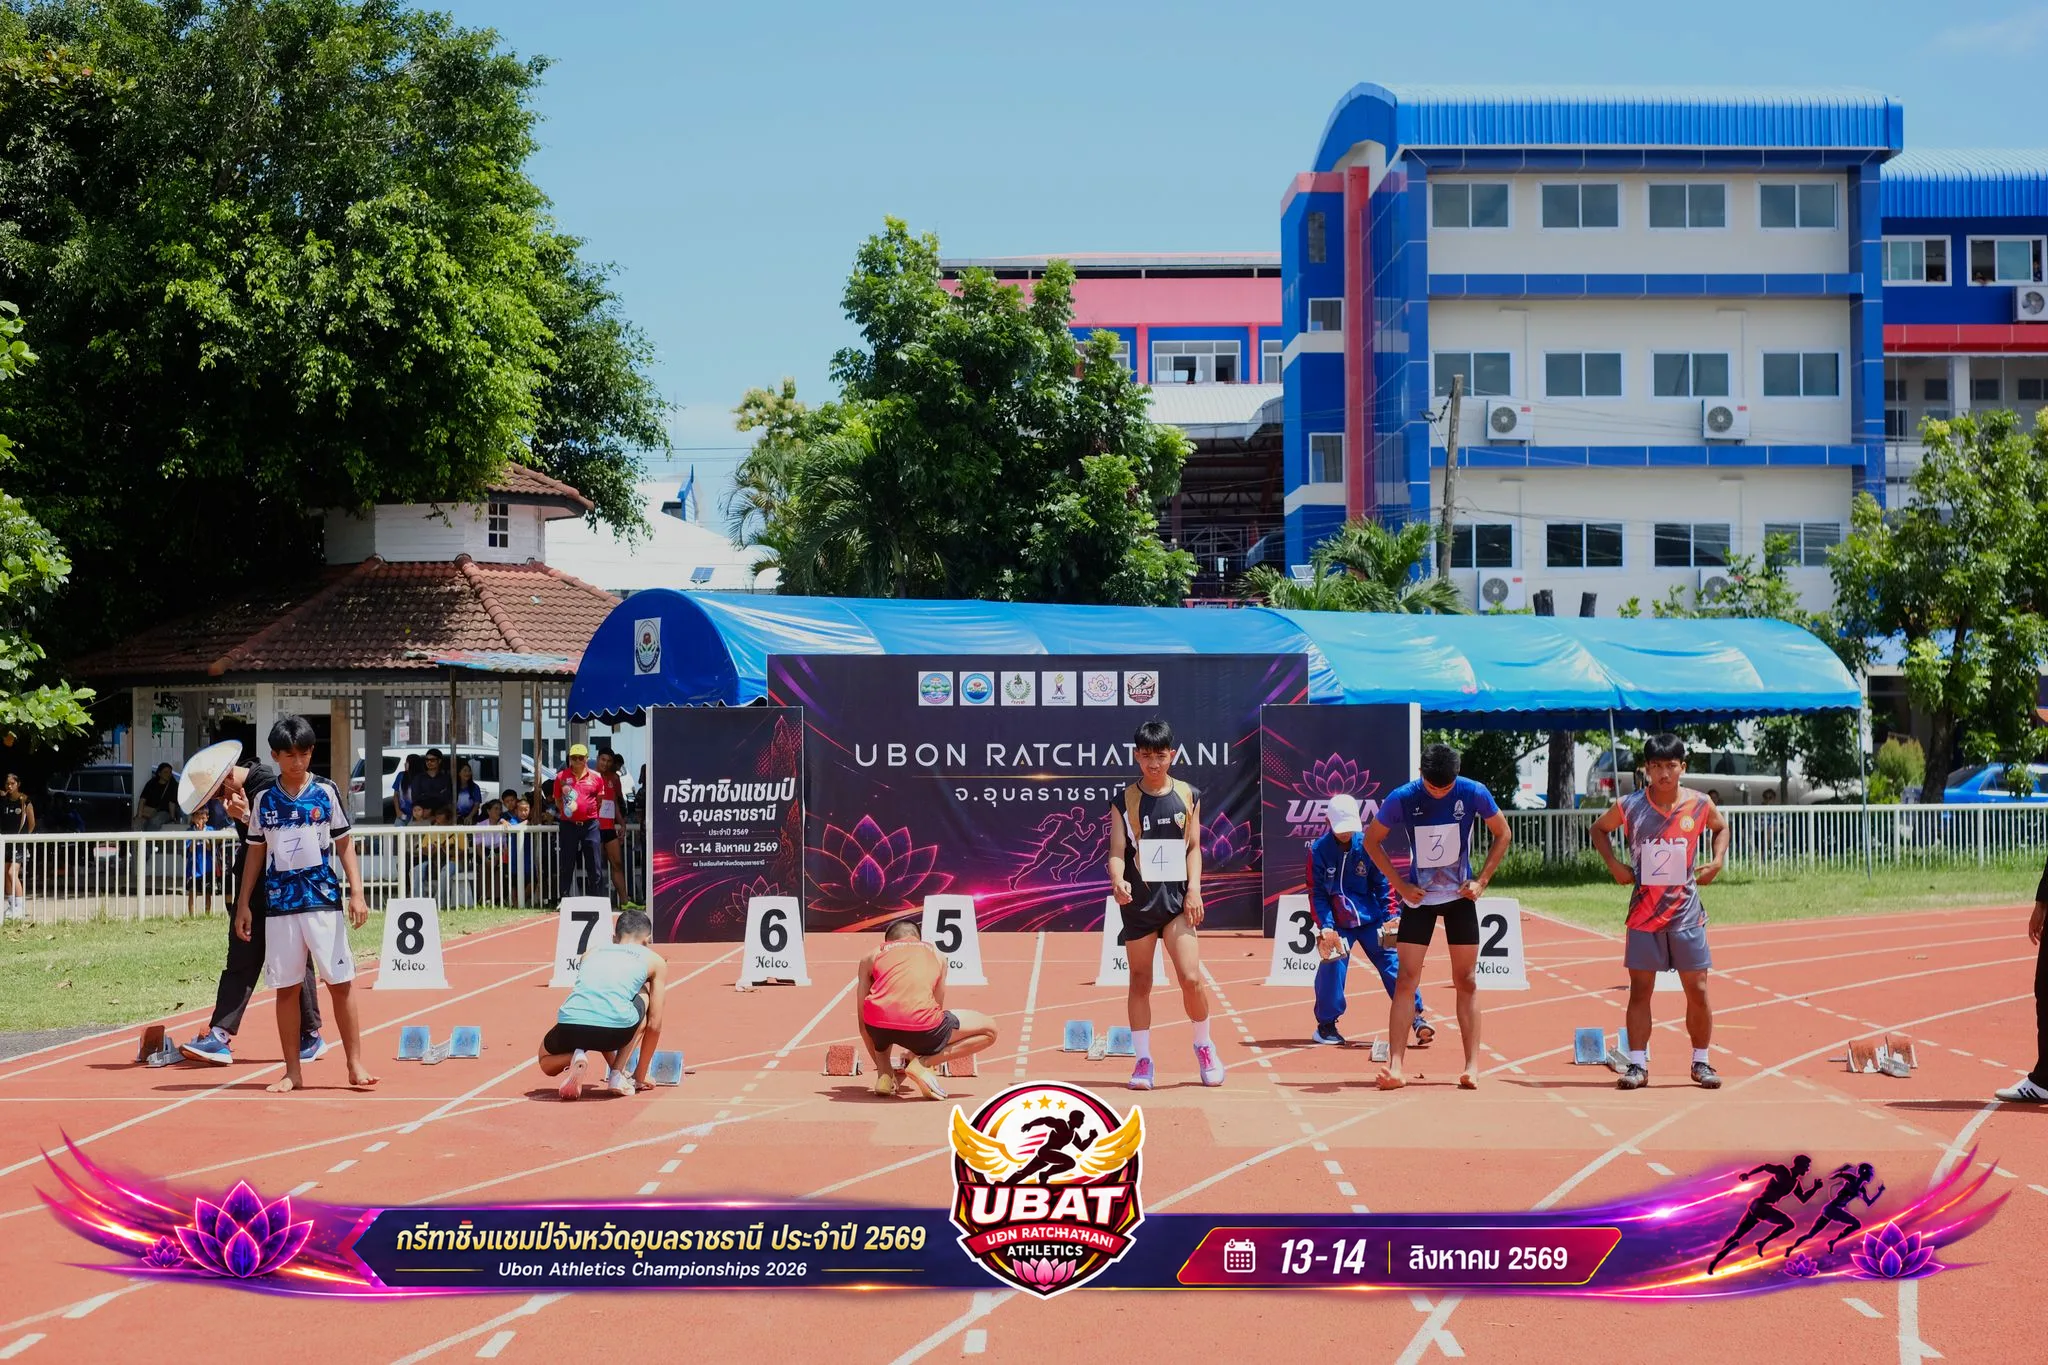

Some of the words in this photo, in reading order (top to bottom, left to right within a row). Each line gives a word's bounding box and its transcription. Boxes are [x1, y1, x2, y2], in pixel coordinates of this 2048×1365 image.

[855, 744, 965, 767] UBON
[986, 743, 1230, 767] RATCHATANI
[663, 776, 796, 804] กรีฑาชิงแชมป์
[1286, 799, 1384, 823] UBN
[733, 828, 749, 836] 2569
[284, 837, 303, 861] 7
[714, 842, 750, 854] สิงหาคม
[753, 842, 778, 853] 2569
[1151, 845, 1169, 872] 4
[1427, 834, 1444, 862] 3
[1651, 849, 1671, 877] 2
[396, 911, 424, 955] 8
[571, 911, 600, 955] 7
[760, 909, 788, 953] 6
[935, 909, 963, 953] 5
[1288, 910, 1316, 954] 3
[1480, 914, 1509, 957] 2
[392, 959, 425, 971] Nelco
[755, 956, 789, 968] Nelco
[1283, 957, 1317, 970] Nelco
[1476, 961, 1510, 974] Nelco
